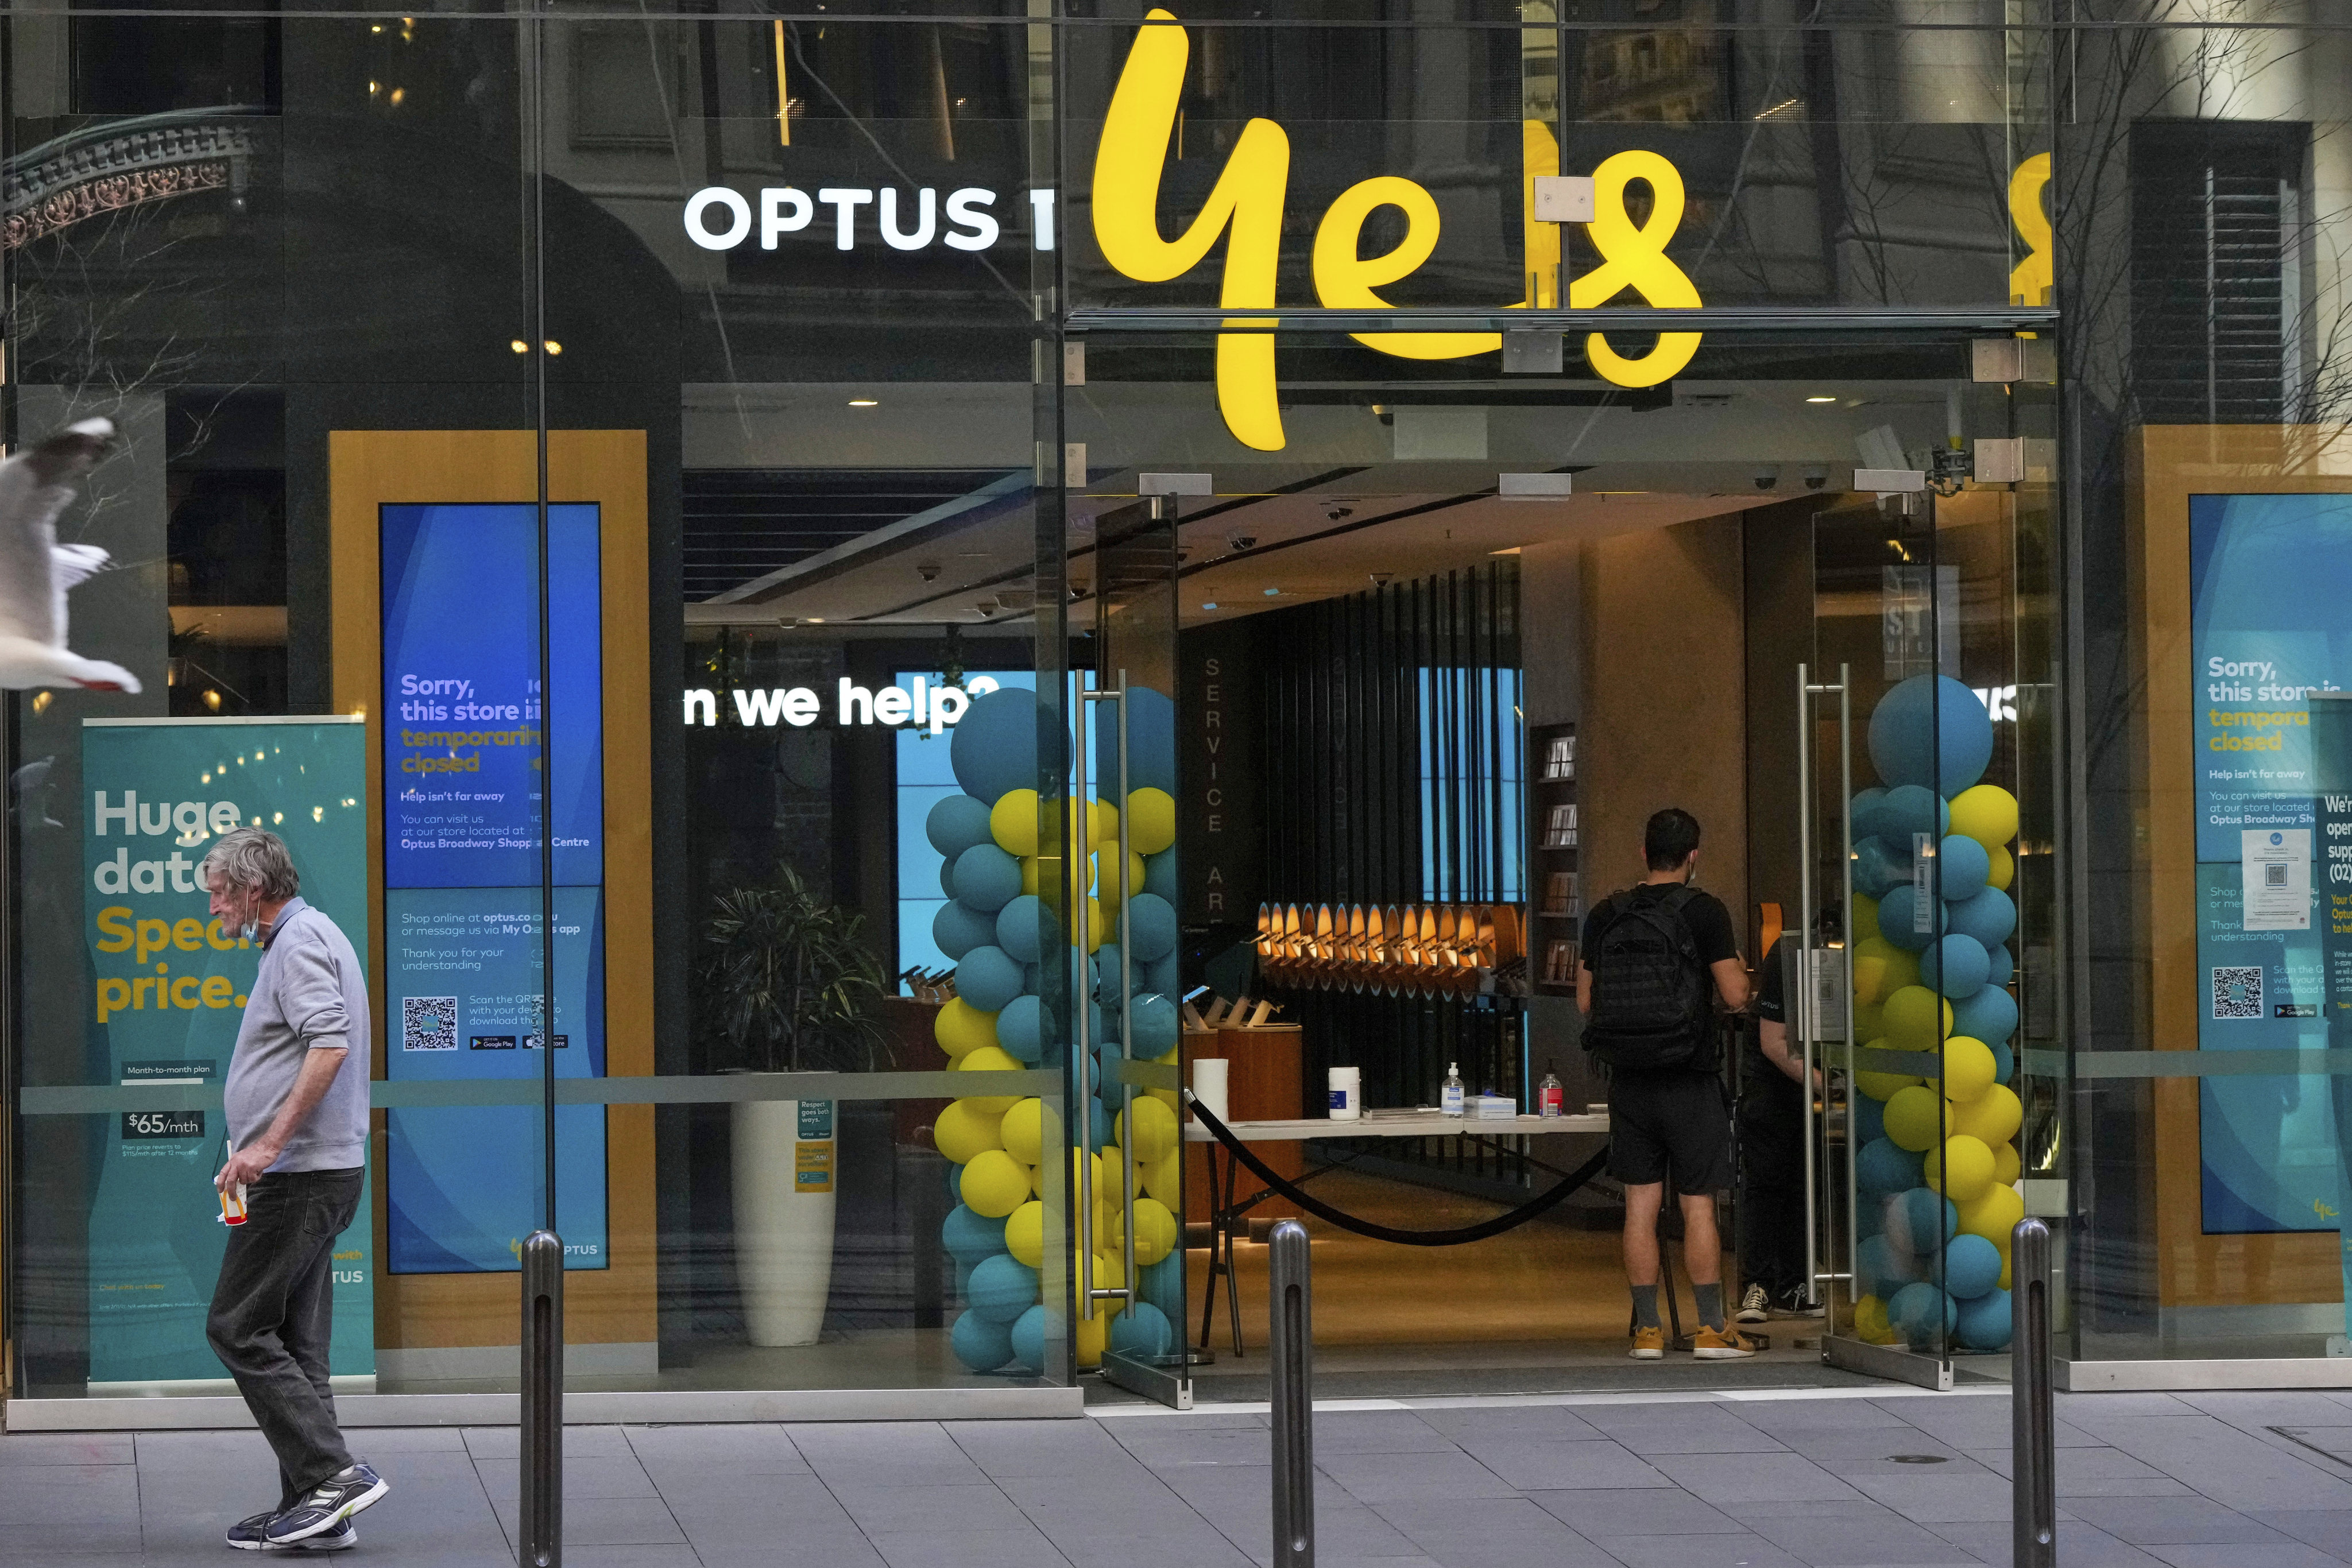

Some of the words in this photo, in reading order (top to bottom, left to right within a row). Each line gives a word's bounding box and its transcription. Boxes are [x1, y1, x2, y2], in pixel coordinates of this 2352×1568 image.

[683, 187, 999, 251] OPTUS
[2208, 657, 2276, 682] Sorry,
[401, 674, 474, 700] Sorry,
[2208, 681, 2252, 702] this
[400, 699, 448, 721] this
[454, 702, 519, 721] store
[733, 687, 820, 726] we
[1206, 659, 1222, 832] SERVICE
[2210, 731, 2282, 751] closed
[401, 752, 479, 772] closed
[2209, 770, 2233, 780] Help
[2235, 769, 2257, 779] isn't
[2260, 769, 2275, 779] far
[2277, 771, 2305, 780] away
[401, 792, 426, 803] Help
[455, 792, 471, 801] far
[474, 793, 505, 802] away
[2210, 791, 2227, 800] You
[2252, 791, 2272, 800] visit
[2243, 804, 2269, 812] store
[2273, 802, 2310, 811] located
[95, 790, 241, 847] Huge
[401, 815, 420, 824] You
[447, 814, 468, 823] visit
[2210, 815, 2242, 826] Optus
[2245, 815, 2296, 825] Broadway
[438, 827, 465, 835] store
[469, 826, 509, 835] located
[513, 826, 525, 835] at
[401, 839, 435, 850] Optus
[439, 838, 495, 849] Broadway
[552, 837, 589, 846] Centre
[1208, 867, 1223, 924] AR
[2210, 887, 2237, 897] Shop
[402, 913, 430, 925] Shop
[433, 913, 465, 923] online
[469, 914, 479, 922] at
[417, 927, 465, 937] message
[484, 926, 499, 934] via
[502, 924, 520, 935] My
[559, 925, 581, 935] app
[2211, 921, 2242, 930] Thank
[2211, 931, 2284, 942] understanding
[403, 948, 435, 957] Thank
[439, 950, 458, 959] you
[461, 948, 477, 957] for
[481, 950, 504, 958] your
[403, 960, 481, 971] understanding
[2274, 966, 2296, 974] Scan
[2296, 977, 2316, 985] your
[97, 962, 246, 1023] price.
[2274, 985, 2318, 994] download
[469, 996, 493, 1004] Scan
[496, 995, 513, 1004] the
[516, 994, 531, 1003] QR
[469, 1005, 491, 1015] with
[494, 1007, 515, 1016] your
[469, 1016, 517, 1025] download
[129, 1113, 198, 1133] $65/mth
[333, 1249, 362, 1260] with
